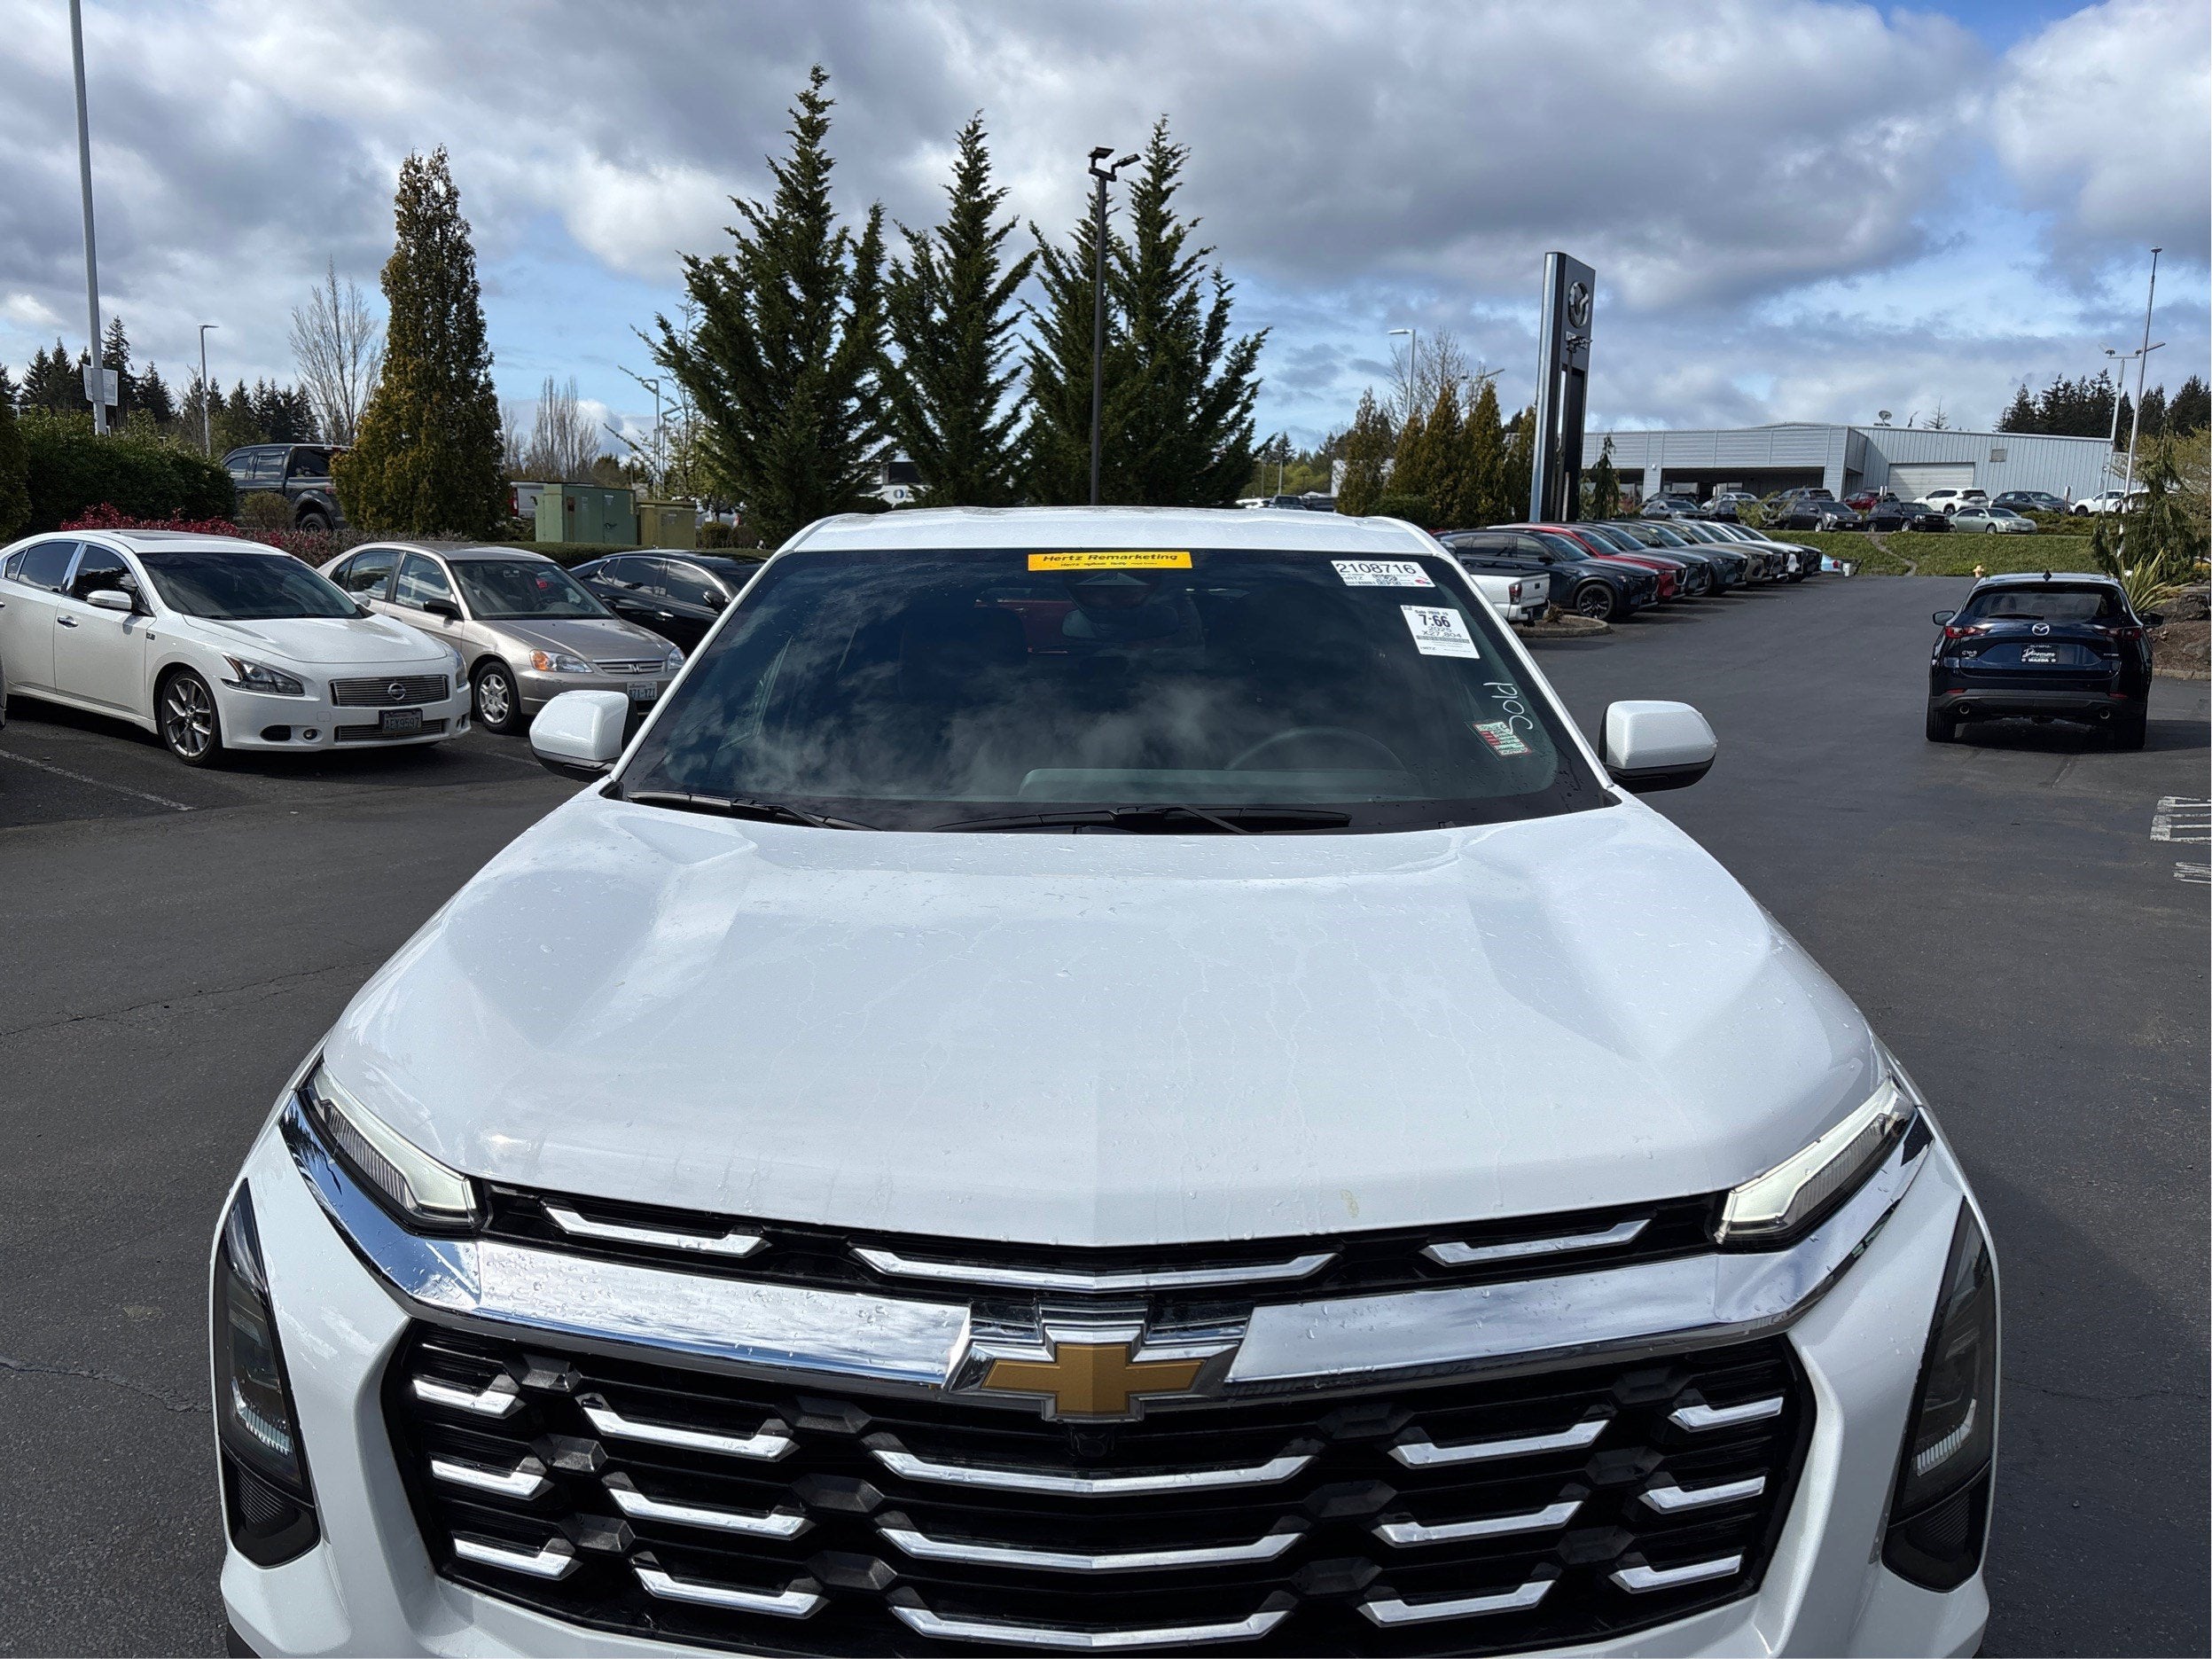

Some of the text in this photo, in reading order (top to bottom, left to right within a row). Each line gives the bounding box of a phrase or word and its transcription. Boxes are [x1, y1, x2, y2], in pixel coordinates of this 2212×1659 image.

[1335, 563, 1417, 575] 2108716
[1418, 614, 1451, 628] 7:66
[1482, 682, 1534, 734] Sold
